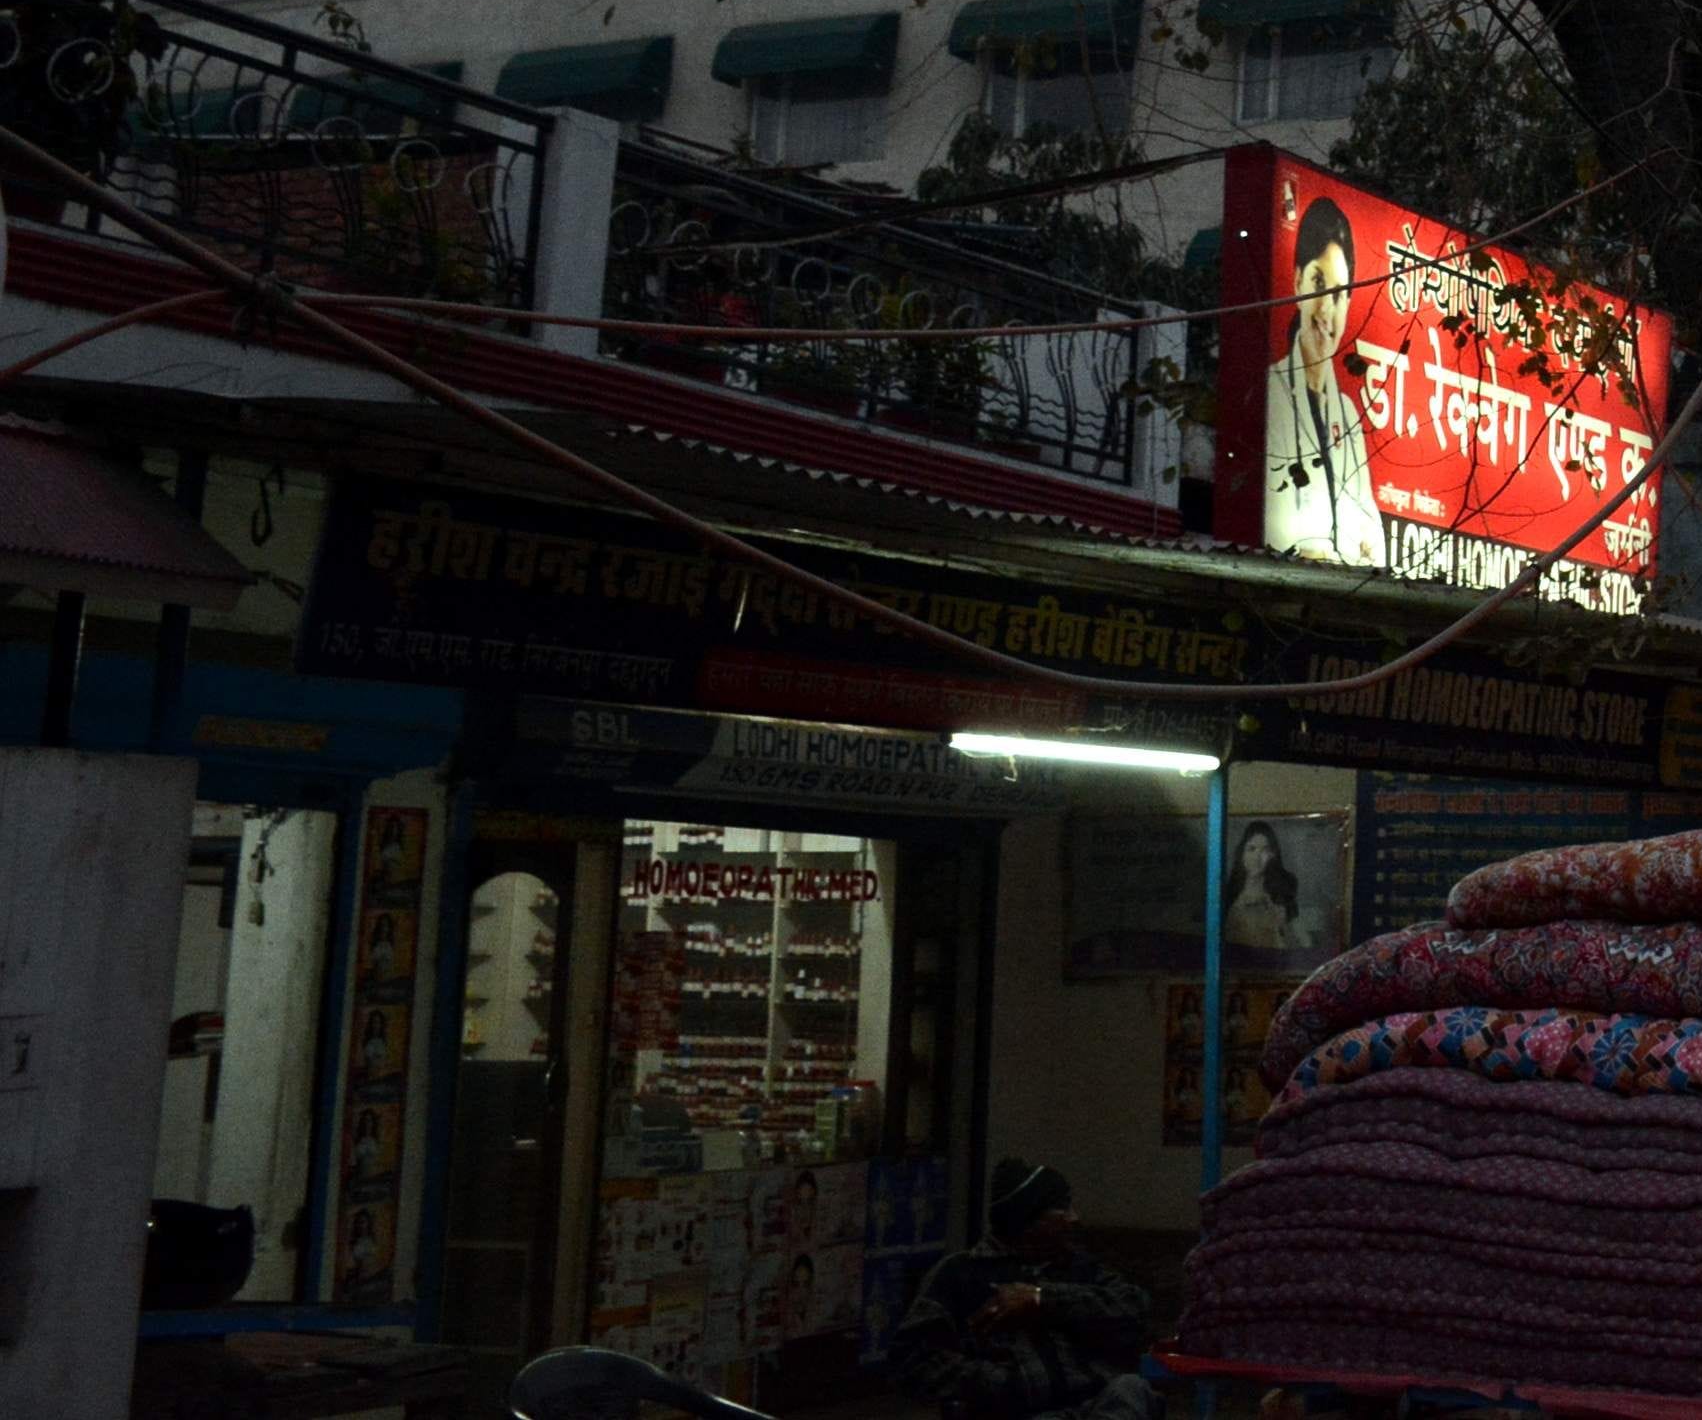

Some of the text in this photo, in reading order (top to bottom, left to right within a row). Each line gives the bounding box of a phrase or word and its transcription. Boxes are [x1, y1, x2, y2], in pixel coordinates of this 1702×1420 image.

[1544, 402, 1612, 501] एण्ड
[1602, 514, 1651, 565] जर्मनी
[571, 710, 639, 746] SBL
[1581, 688, 1648, 746] STORE
[733, 722, 797, 760] LODHI
[757, 767, 821, 790] GMS
[827, 870, 882, 903] MED.
